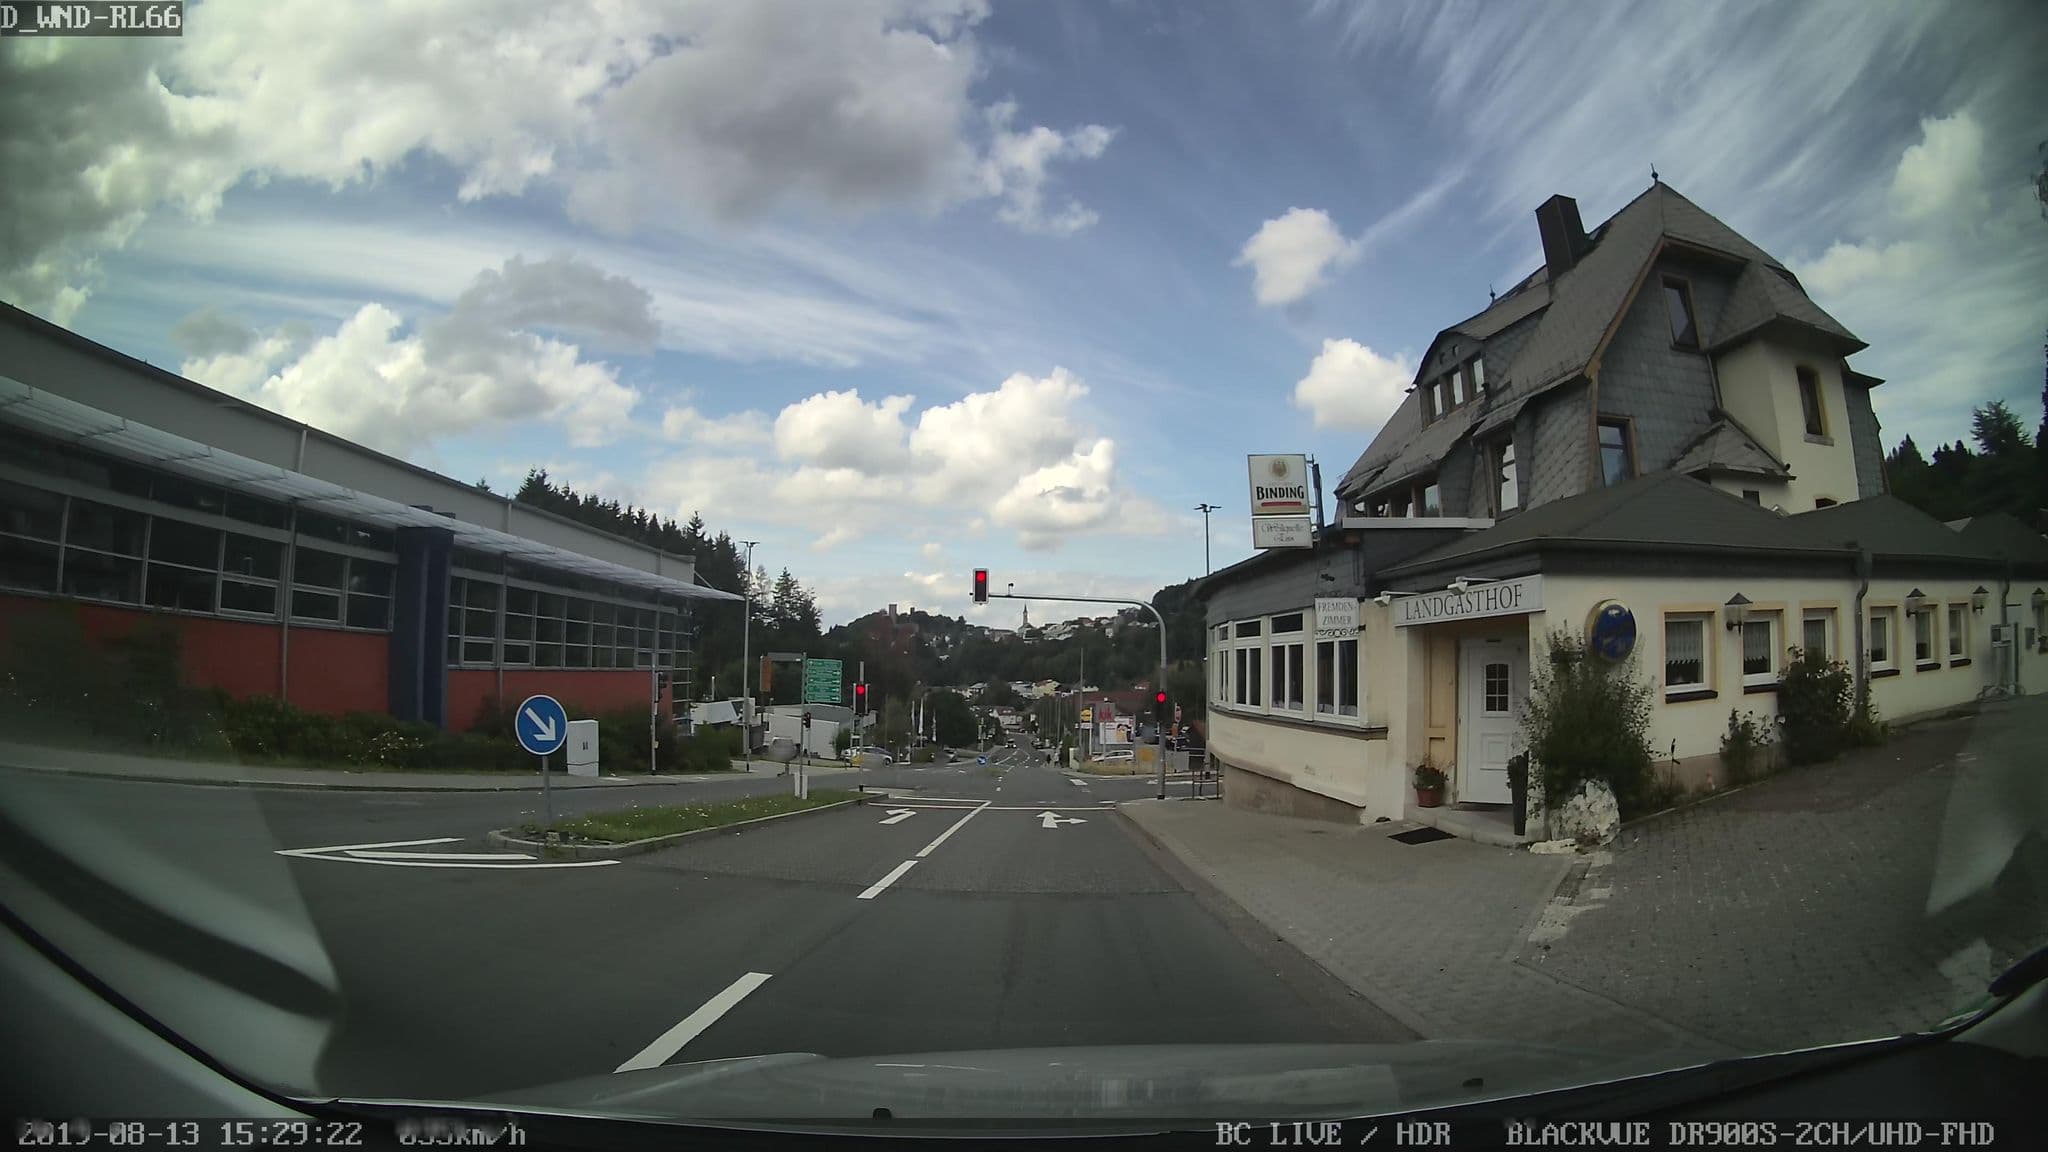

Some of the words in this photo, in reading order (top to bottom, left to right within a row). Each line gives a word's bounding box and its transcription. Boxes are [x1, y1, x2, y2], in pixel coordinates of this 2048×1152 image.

[1256, 485, 1304, 500] BINDING
[1405, 584, 1522, 620] LANDGASTHOF
[1322, 616, 1351, 625] ZIMMER
